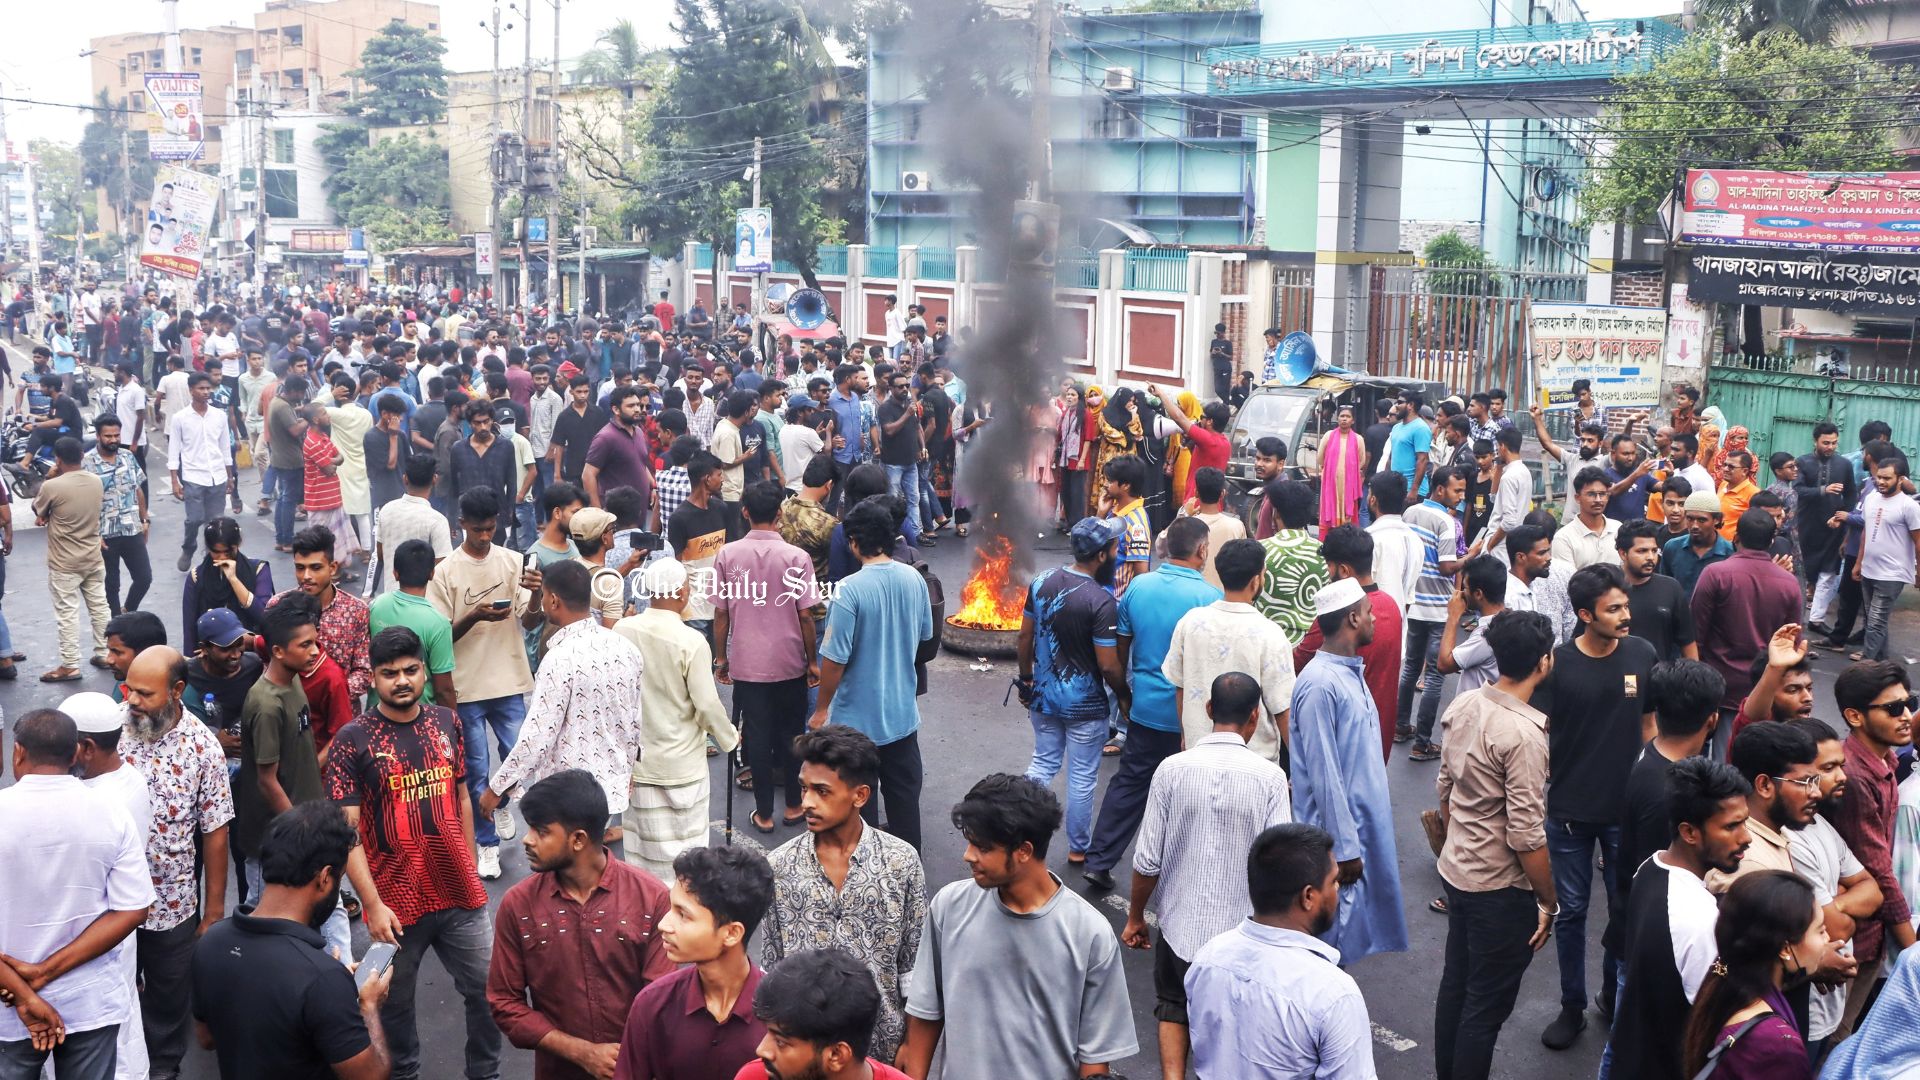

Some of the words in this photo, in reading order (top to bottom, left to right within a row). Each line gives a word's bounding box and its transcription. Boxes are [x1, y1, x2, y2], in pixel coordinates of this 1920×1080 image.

[1402, 39, 1467, 77] পুলিশ
[153, 79, 200, 92] AVIJIT'S
[1841, 189, 1881, 205] কুরআন
[1884, 190, 1893, 202] ও
[1828, 206, 1864, 214] QURAN
[1672, 319, 1684, 336] দান
[1566, 338, 1596, 365] হস্তে
[1599, 337, 1625, 363] দান
[1627, 338, 1664, 363] করুন
[388, 765, 453, 791] Emirates
[401, 787, 415, 803] FLY
[418, 781, 447, 800] BETTER
